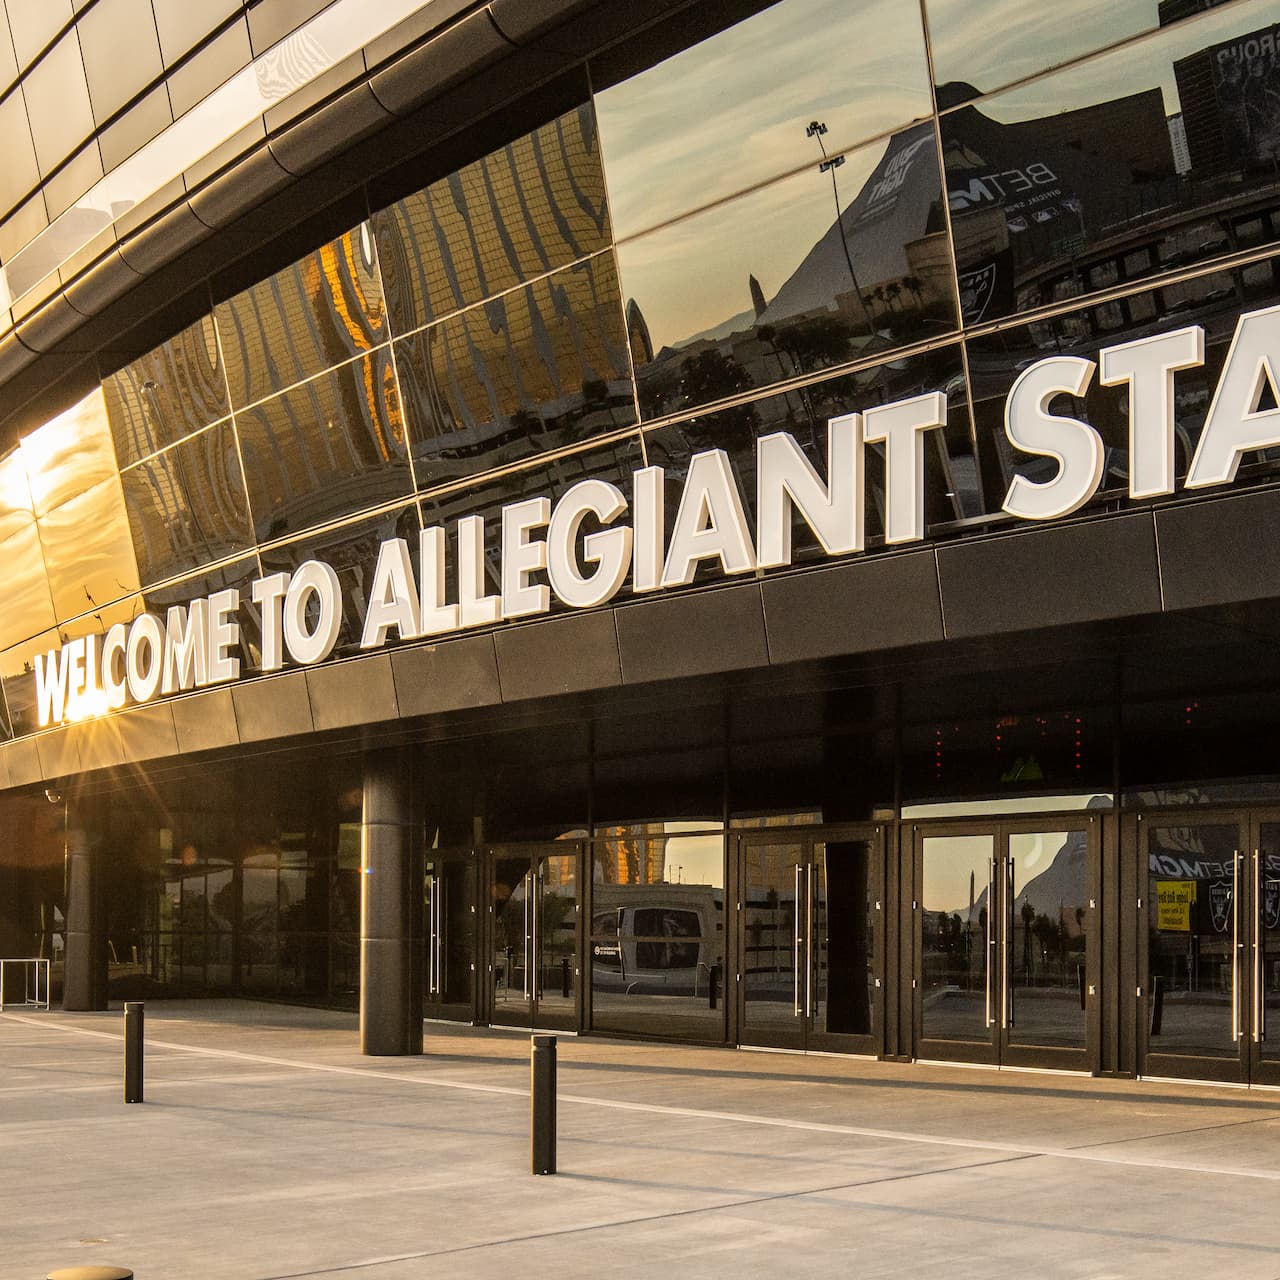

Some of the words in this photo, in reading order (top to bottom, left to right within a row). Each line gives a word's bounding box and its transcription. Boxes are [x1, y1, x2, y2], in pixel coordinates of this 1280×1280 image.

[33, 588, 241, 728] WELCOME
[252, 560, 342, 672] TO
[361, 391, 948, 649] ALLEGIANT
